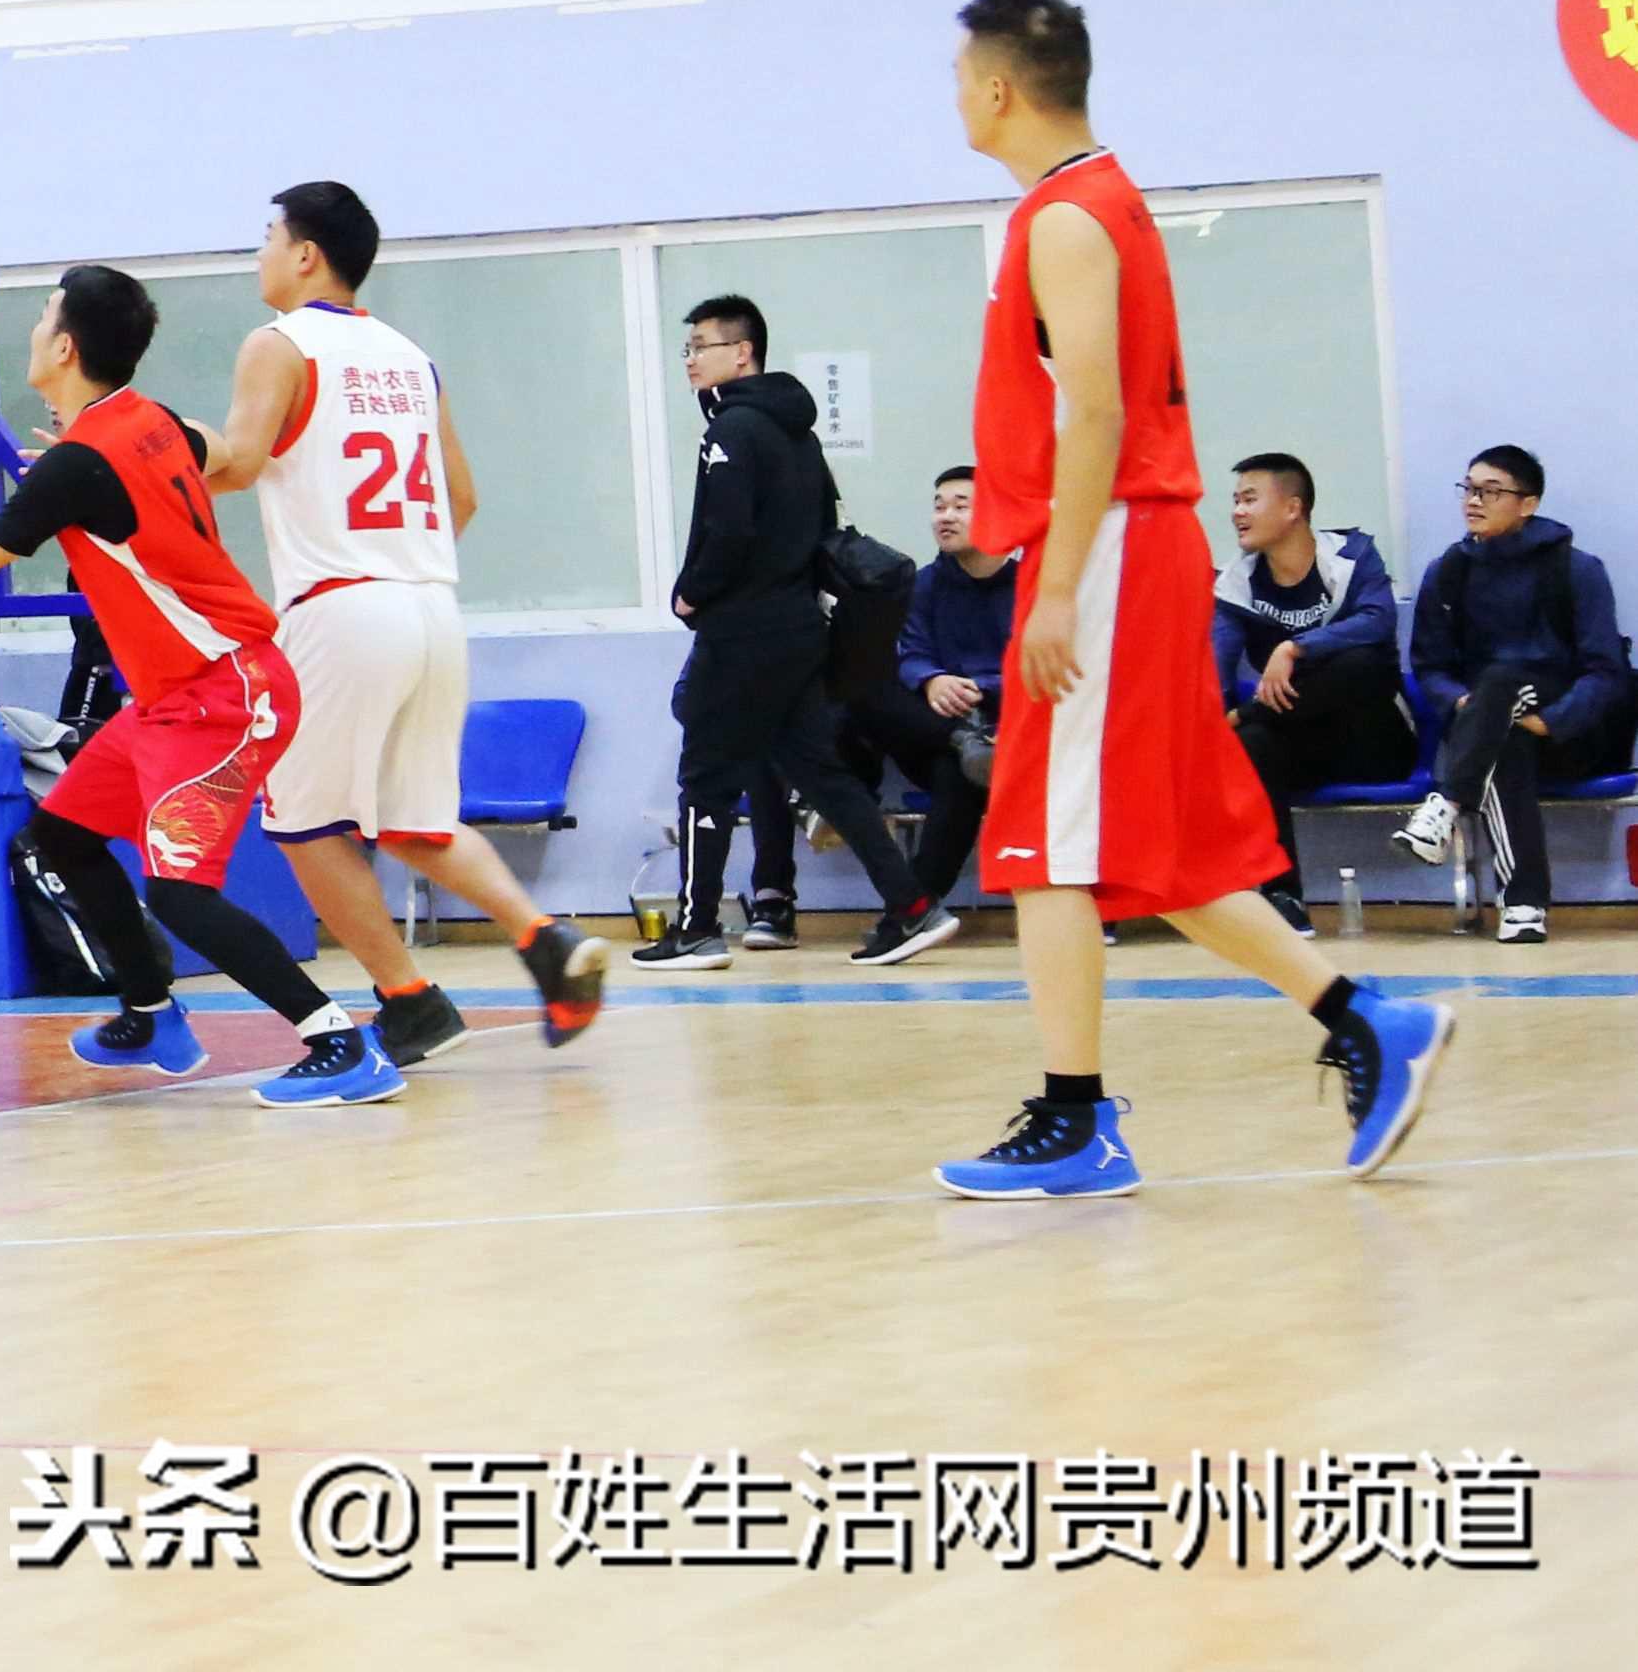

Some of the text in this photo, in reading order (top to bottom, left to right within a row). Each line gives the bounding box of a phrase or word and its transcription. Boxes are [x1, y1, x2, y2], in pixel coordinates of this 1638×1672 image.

[340, 365, 423, 392] 贵州农信
[343, 431, 440, 530] 24
